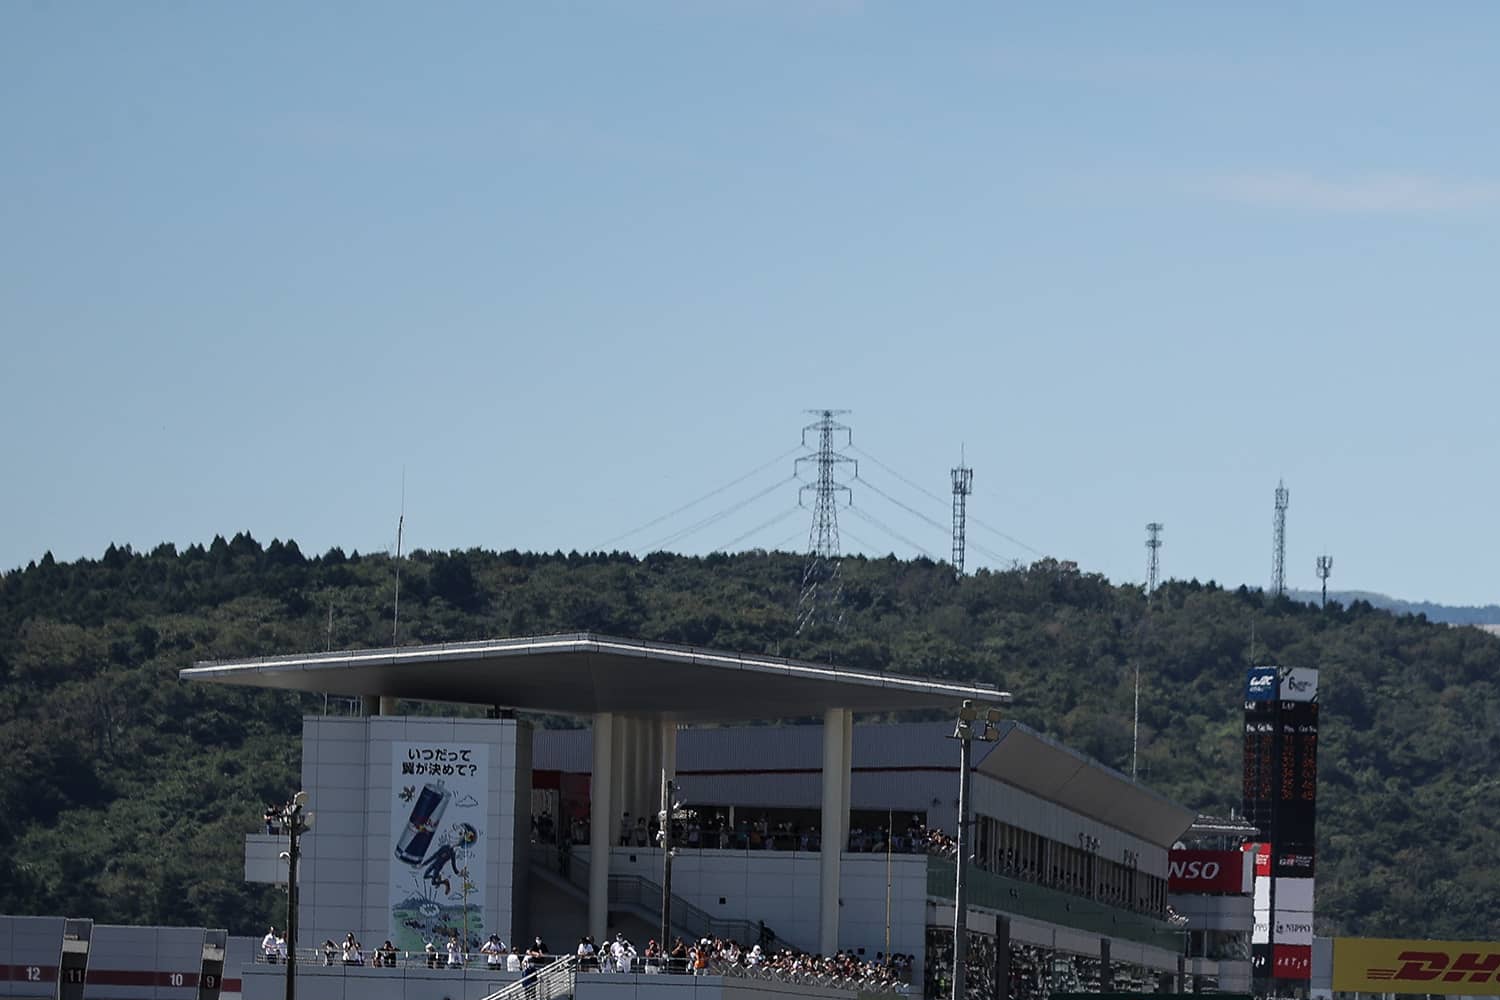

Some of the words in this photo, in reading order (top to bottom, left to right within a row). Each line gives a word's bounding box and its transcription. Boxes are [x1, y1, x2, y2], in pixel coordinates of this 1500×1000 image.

[407, 748, 472, 762] いつだって
[26, 966, 41, 981] 12
[69, 969, 83, 983] 11
[169, 973, 184, 987] 10
[206, 975, 215, 989] 9
